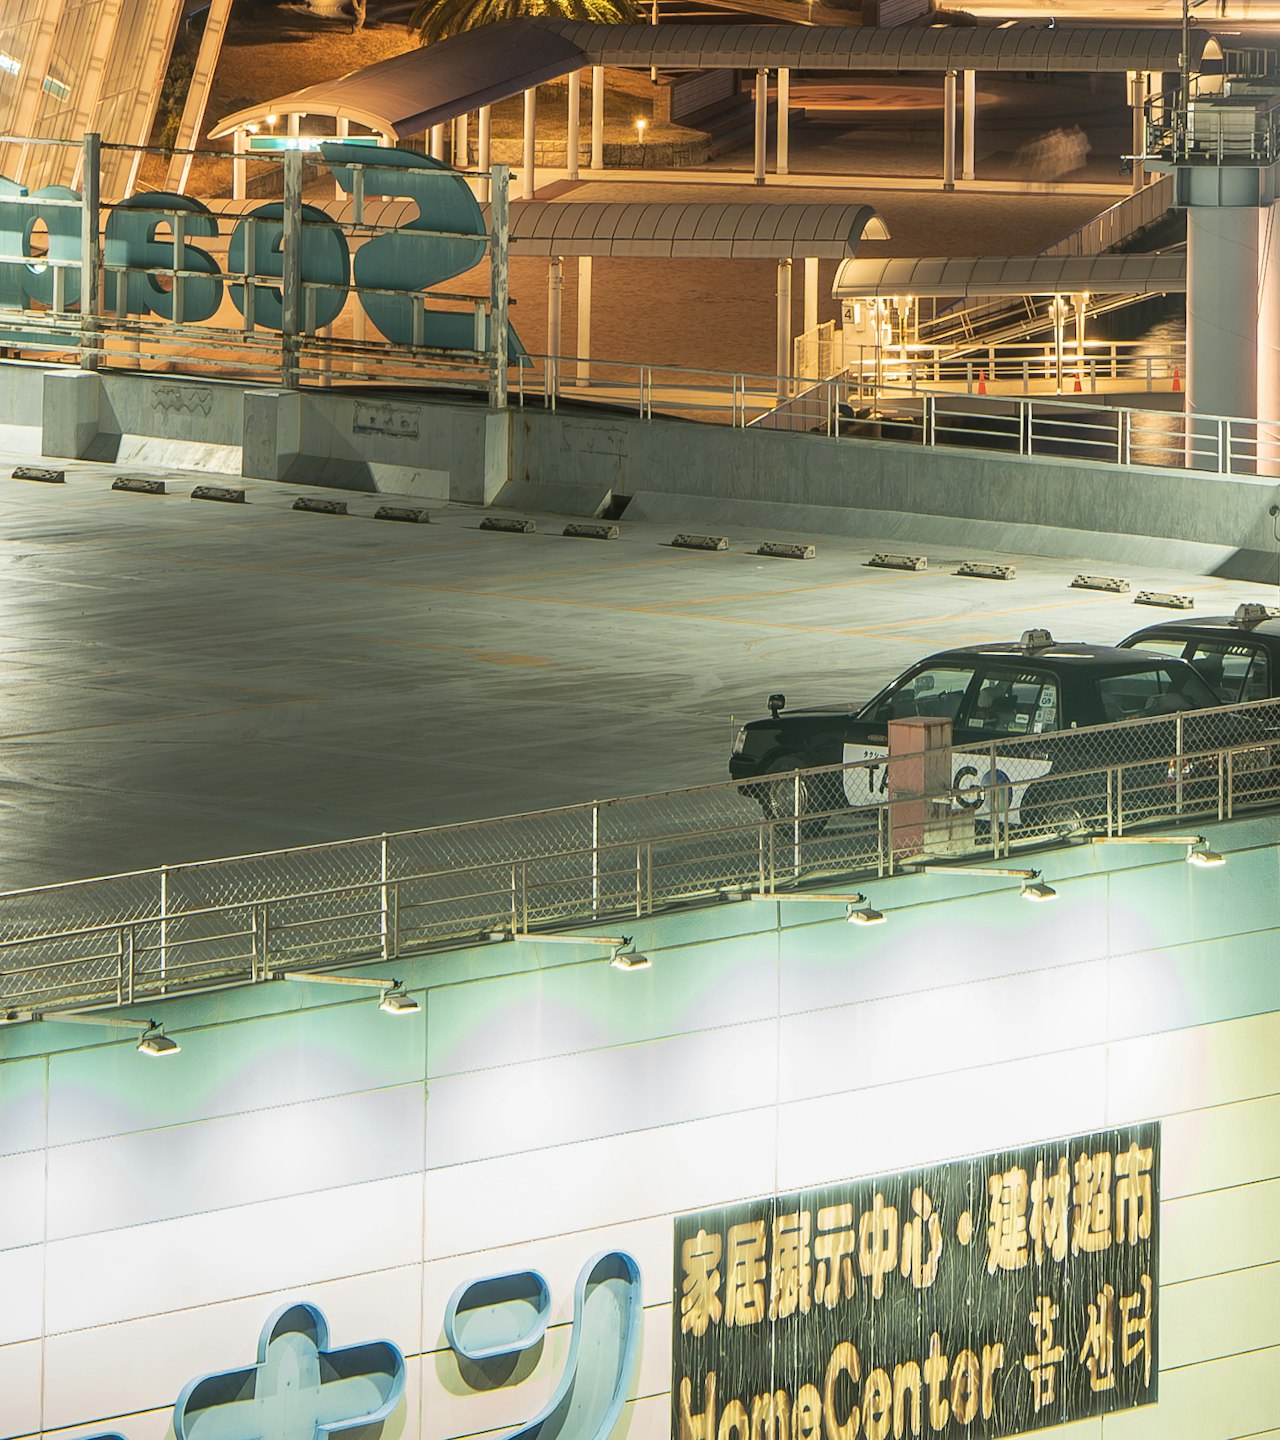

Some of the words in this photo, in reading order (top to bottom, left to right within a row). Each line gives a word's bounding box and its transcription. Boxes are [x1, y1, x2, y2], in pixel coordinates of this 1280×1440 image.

[844, 308, 852, 321] 4
[863, 750, 888, 759] タクシー
